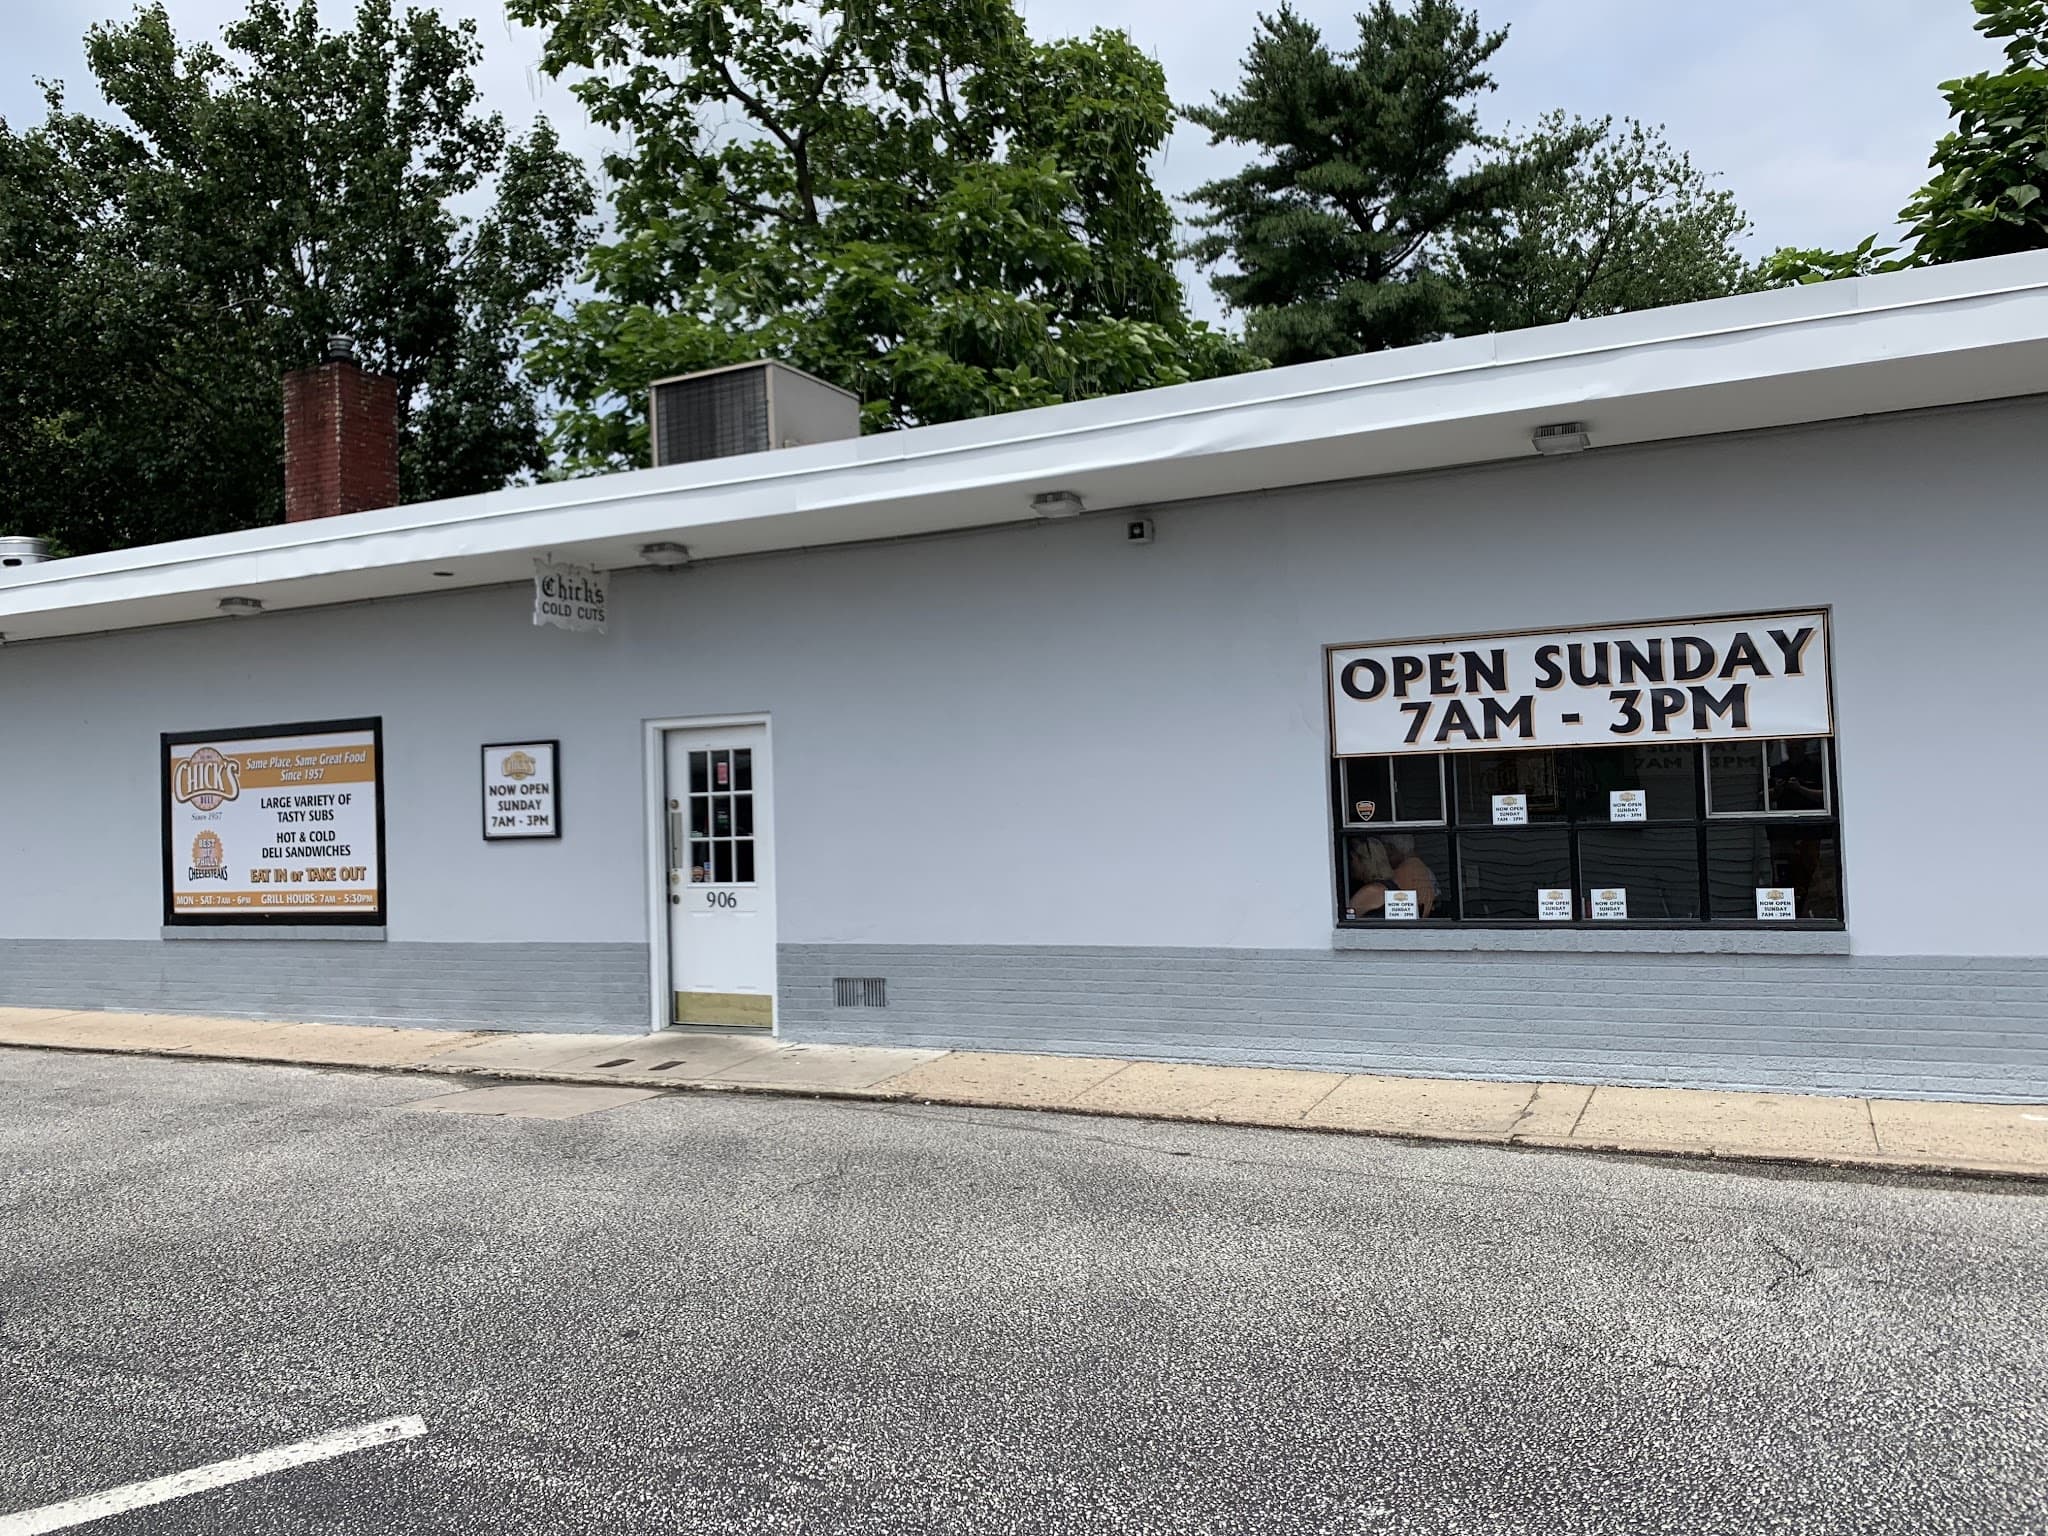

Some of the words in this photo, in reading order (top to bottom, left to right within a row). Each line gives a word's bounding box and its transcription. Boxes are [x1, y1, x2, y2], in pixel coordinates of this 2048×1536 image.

[542, 573, 604, 604] Chick's
[542, 601, 572, 616] COLD
[577, 606, 605, 622] CUTS
[1341, 649, 1508, 701] OPEN
[1535, 628, 1816, 690] SUNDAY
[1400, 695, 1536, 744] 7AM
[1562, 712, 1582, 724] -
[1609, 683, 1750, 735] 3PM
[246, 758, 267, 770] Same
[269, 756, 293, 769] Place,
[295, 754, 317, 767] Same
[319, 752, 343, 765] Great
[344, 751, 367, 763] Food
[174, 758, 240, 804] CHICK'S
[280, 769, 302, 781] Since
[304, 768, 325, 780] 1957
[489, 785, 516, 796] NOW
[520, 783, 550, 795] OPEN
[261, 796, 291, 809] LARGE
[294, 794, 335, 807] VARIETY
[338, 793, 352, 805] OF
[498, 799, 542, 811] SUNDAY
[277, 811, 306, 823] TASTY
[308, 809, 335, 822] SUBS
[491, 815, 516, 827] 7AM
[526, 815, 550, 827] 3PM
[276, 832, 296, 844] HOT
[299, 831, 306, 842] &
[309, 830, 336, 843] COLD
[262, 847, 282, 859] DELI
[285, 845, 351, 858] SANDWICHES
[188, 866, 228, 881] CHEESESTEAKS
[250, 869, 271, 883] EAT
[274, 868, 288, 883] IN
[290, 870, 304, 882] or
[305, 867, 337, 882] TAKE
[340, 866, 367, 881] OUT
[176, 895, 194, 905] MON
[200, 895, 215, 905] SAT:
[261, 894, 284, 904] GRILL
[286, 893, 318, 904] HOURS:
[319, 894, 336, 903] 7AM
[343, 893, 374, 903] 5:30PM
[707, 891, 737, 908] 906
